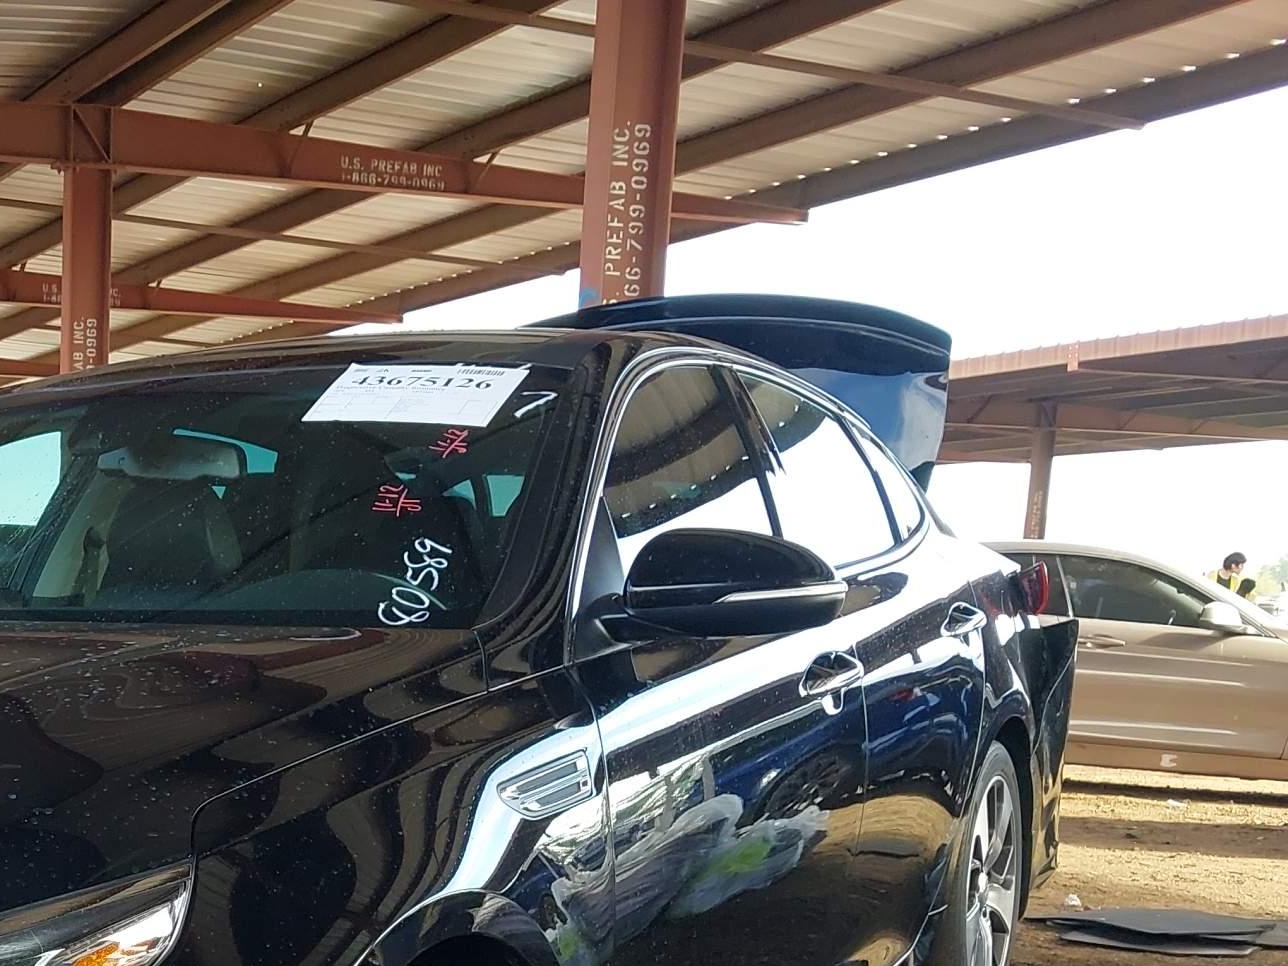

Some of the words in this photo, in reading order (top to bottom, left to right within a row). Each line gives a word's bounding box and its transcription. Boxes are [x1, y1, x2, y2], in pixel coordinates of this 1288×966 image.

[613, 120, 632, 167] INC.
[340, 155, 365, 171] U.S.
[371, 158, 418, 174] PREFAB
[605, 181, 626, 276] PREFAB
[352, 375, 494, 391] 43675126
